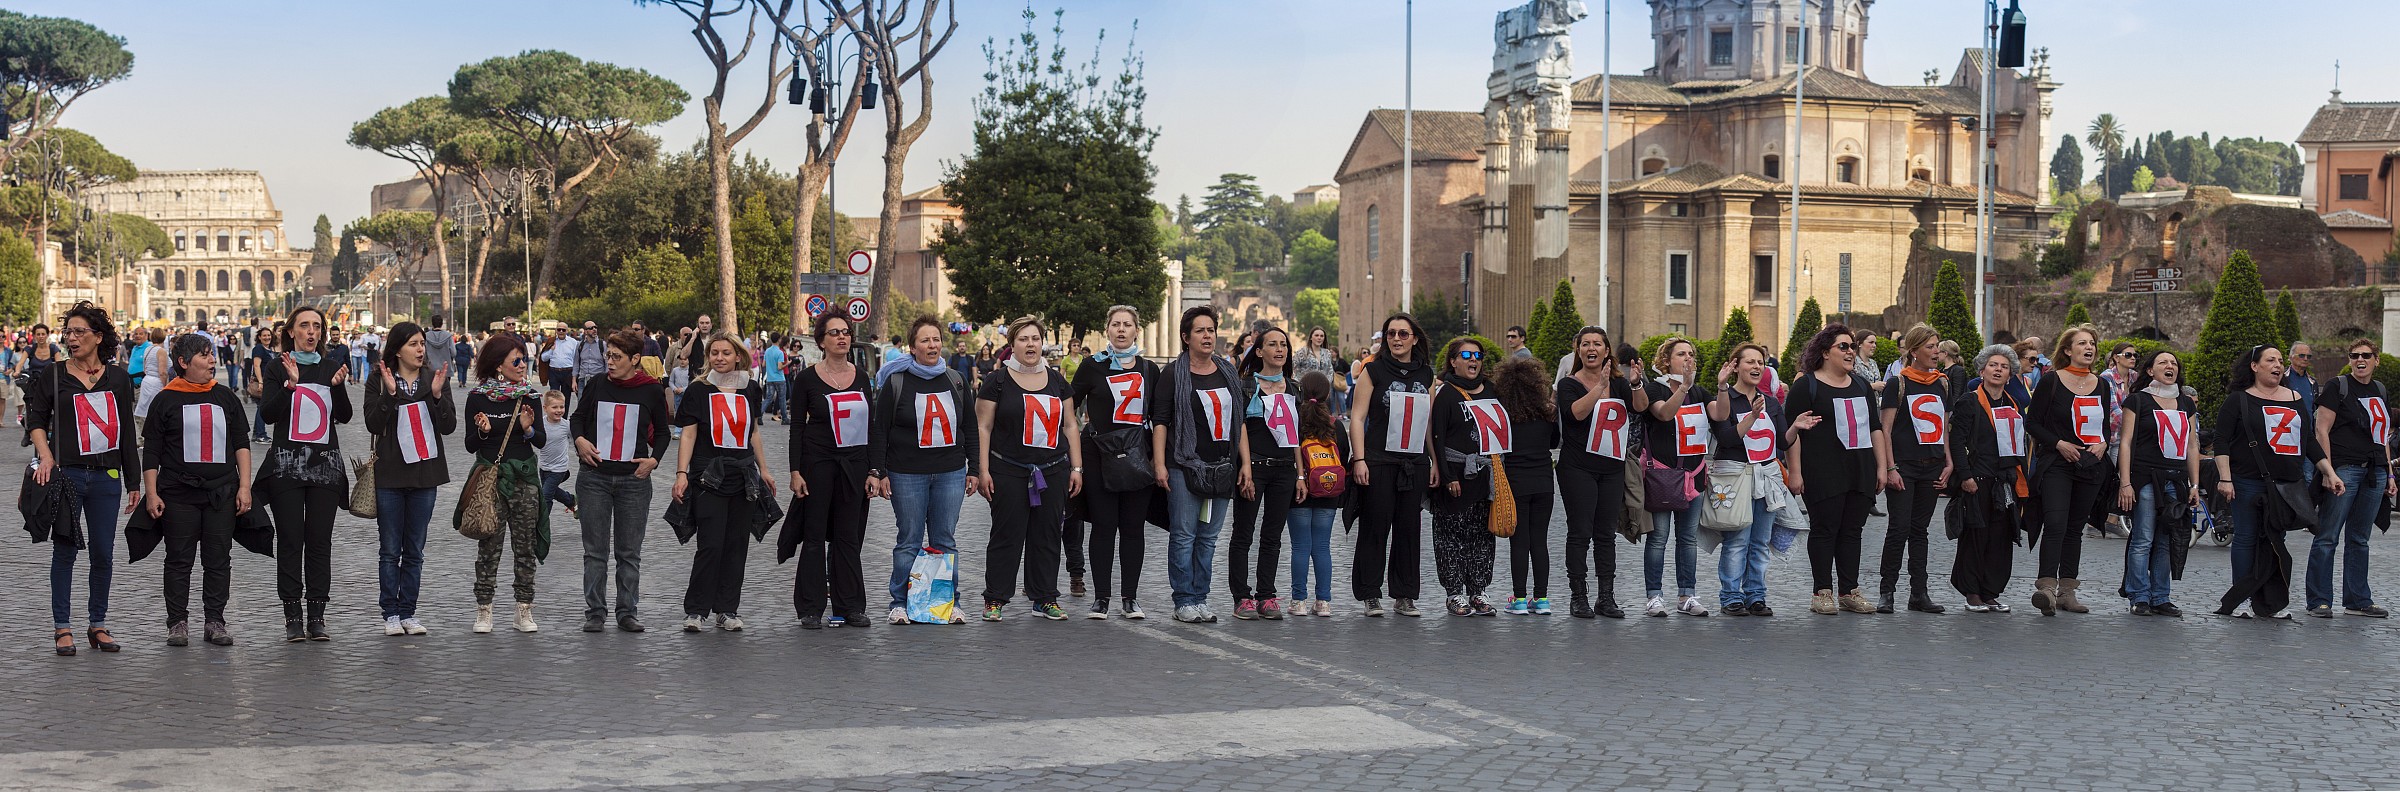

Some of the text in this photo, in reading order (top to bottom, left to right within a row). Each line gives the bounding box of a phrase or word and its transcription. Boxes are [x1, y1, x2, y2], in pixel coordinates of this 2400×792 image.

[852, 304, 865, 315] 30
[74, 392, 118, 452] N
[289, 385, 328, 441] D
[712, 394, 747, 446] N
[830, 393, 863, 445] F
[919, 395, 954, 447] A
[1023, 395, 1061, 448] N
[1109, 373, 1142, 423] Z
[1206, 391, 1223, 440] I
[1267, 394, 1299, 445] A
[1401, 396, 1414, 449] I
[1911, 395, 1944, 443] S
[2073, 398, 2104, 443] E
[2369, 398, 2387, 444] A
[200, 405, 213, 462] I
[407, 404, 429, 460] I
[611, 405, 626, 460] I
[1471, 404, 1509, 453] N
[1592, 402, 1626, 457] R
[1676, 405, 1707, 455] E
[1743, 412, 1775, 461] S
[1844, 400, 1858, 447] I
[1994, 408, 2021, 454] T
[2156, 411, 2189, 457] N
[2264, 406, 2299, 454] Z
